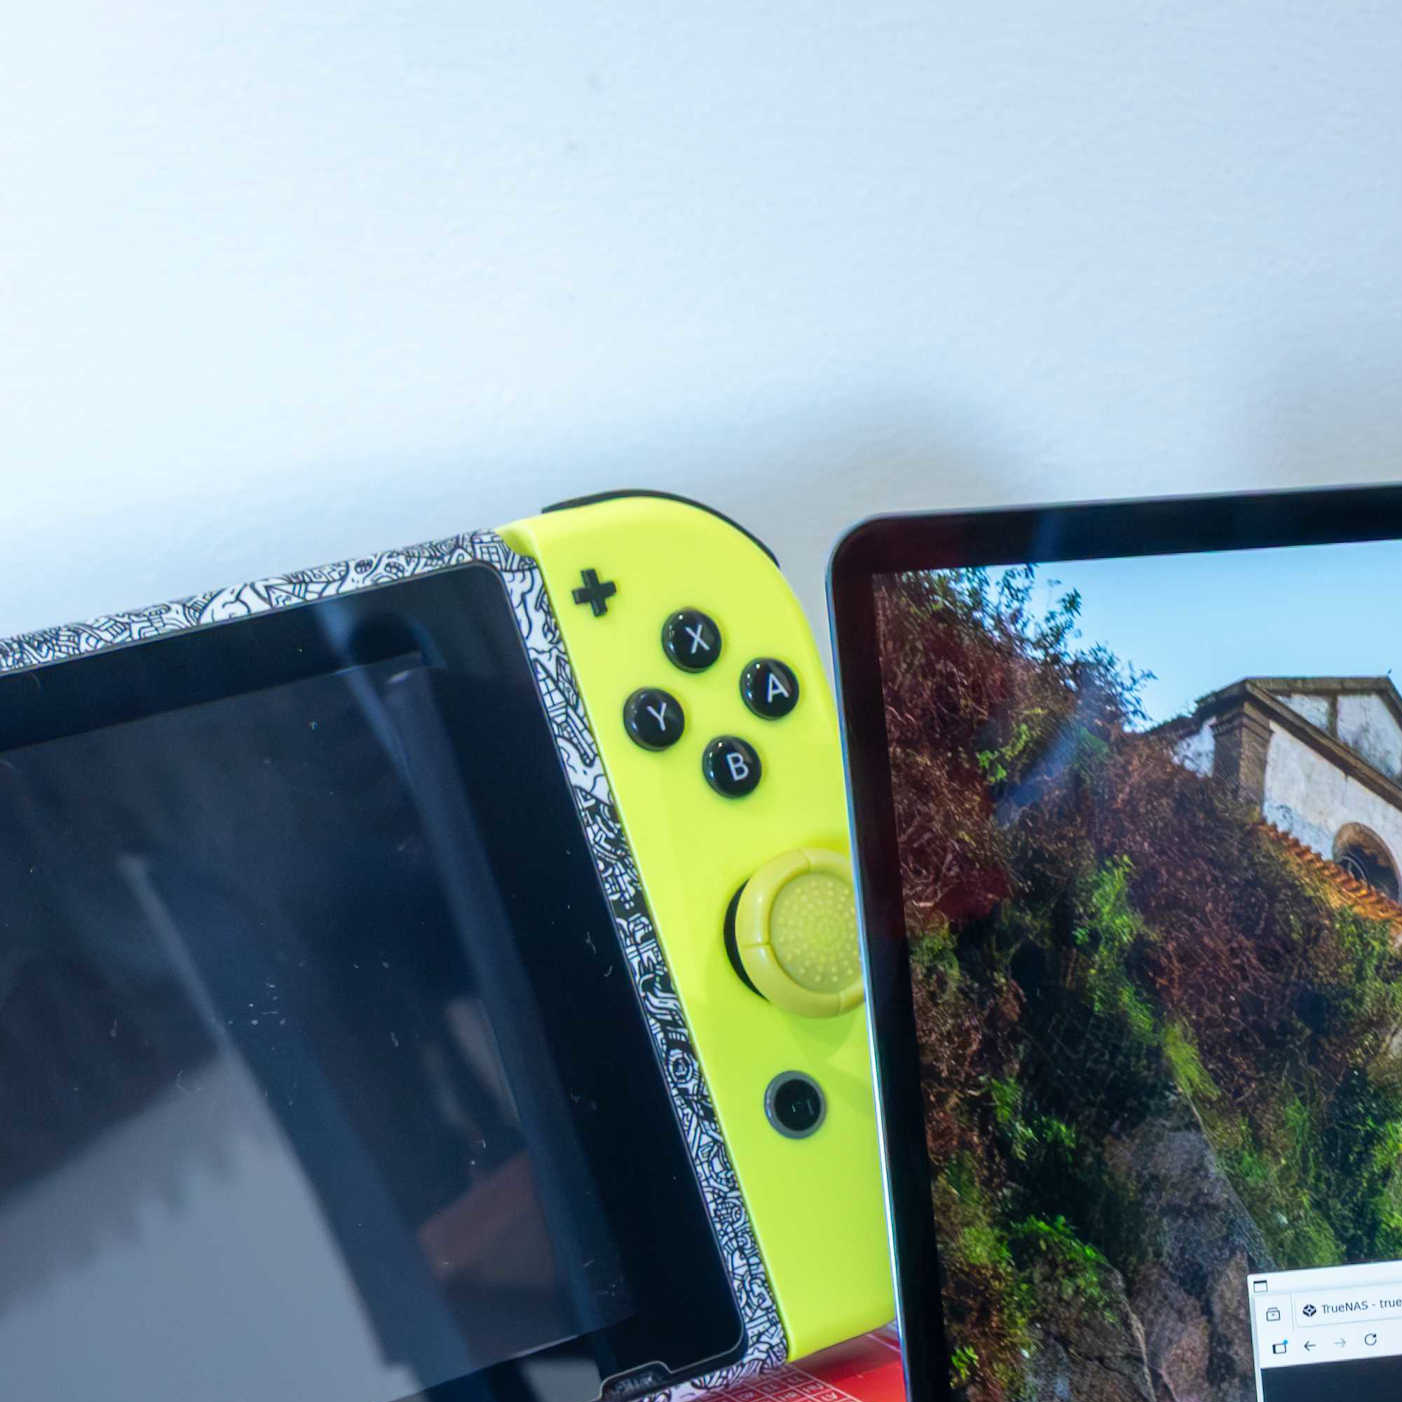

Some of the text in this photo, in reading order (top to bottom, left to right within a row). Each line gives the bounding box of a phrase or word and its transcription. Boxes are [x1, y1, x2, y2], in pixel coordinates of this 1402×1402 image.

[686, 624, 709, 653] X
[766, 671, 790, 703] A
[648, 702, 666, 730] Y
[727, 753, 748, 780] B
[1321, 1300, 1369, 1315] TrueNAS
